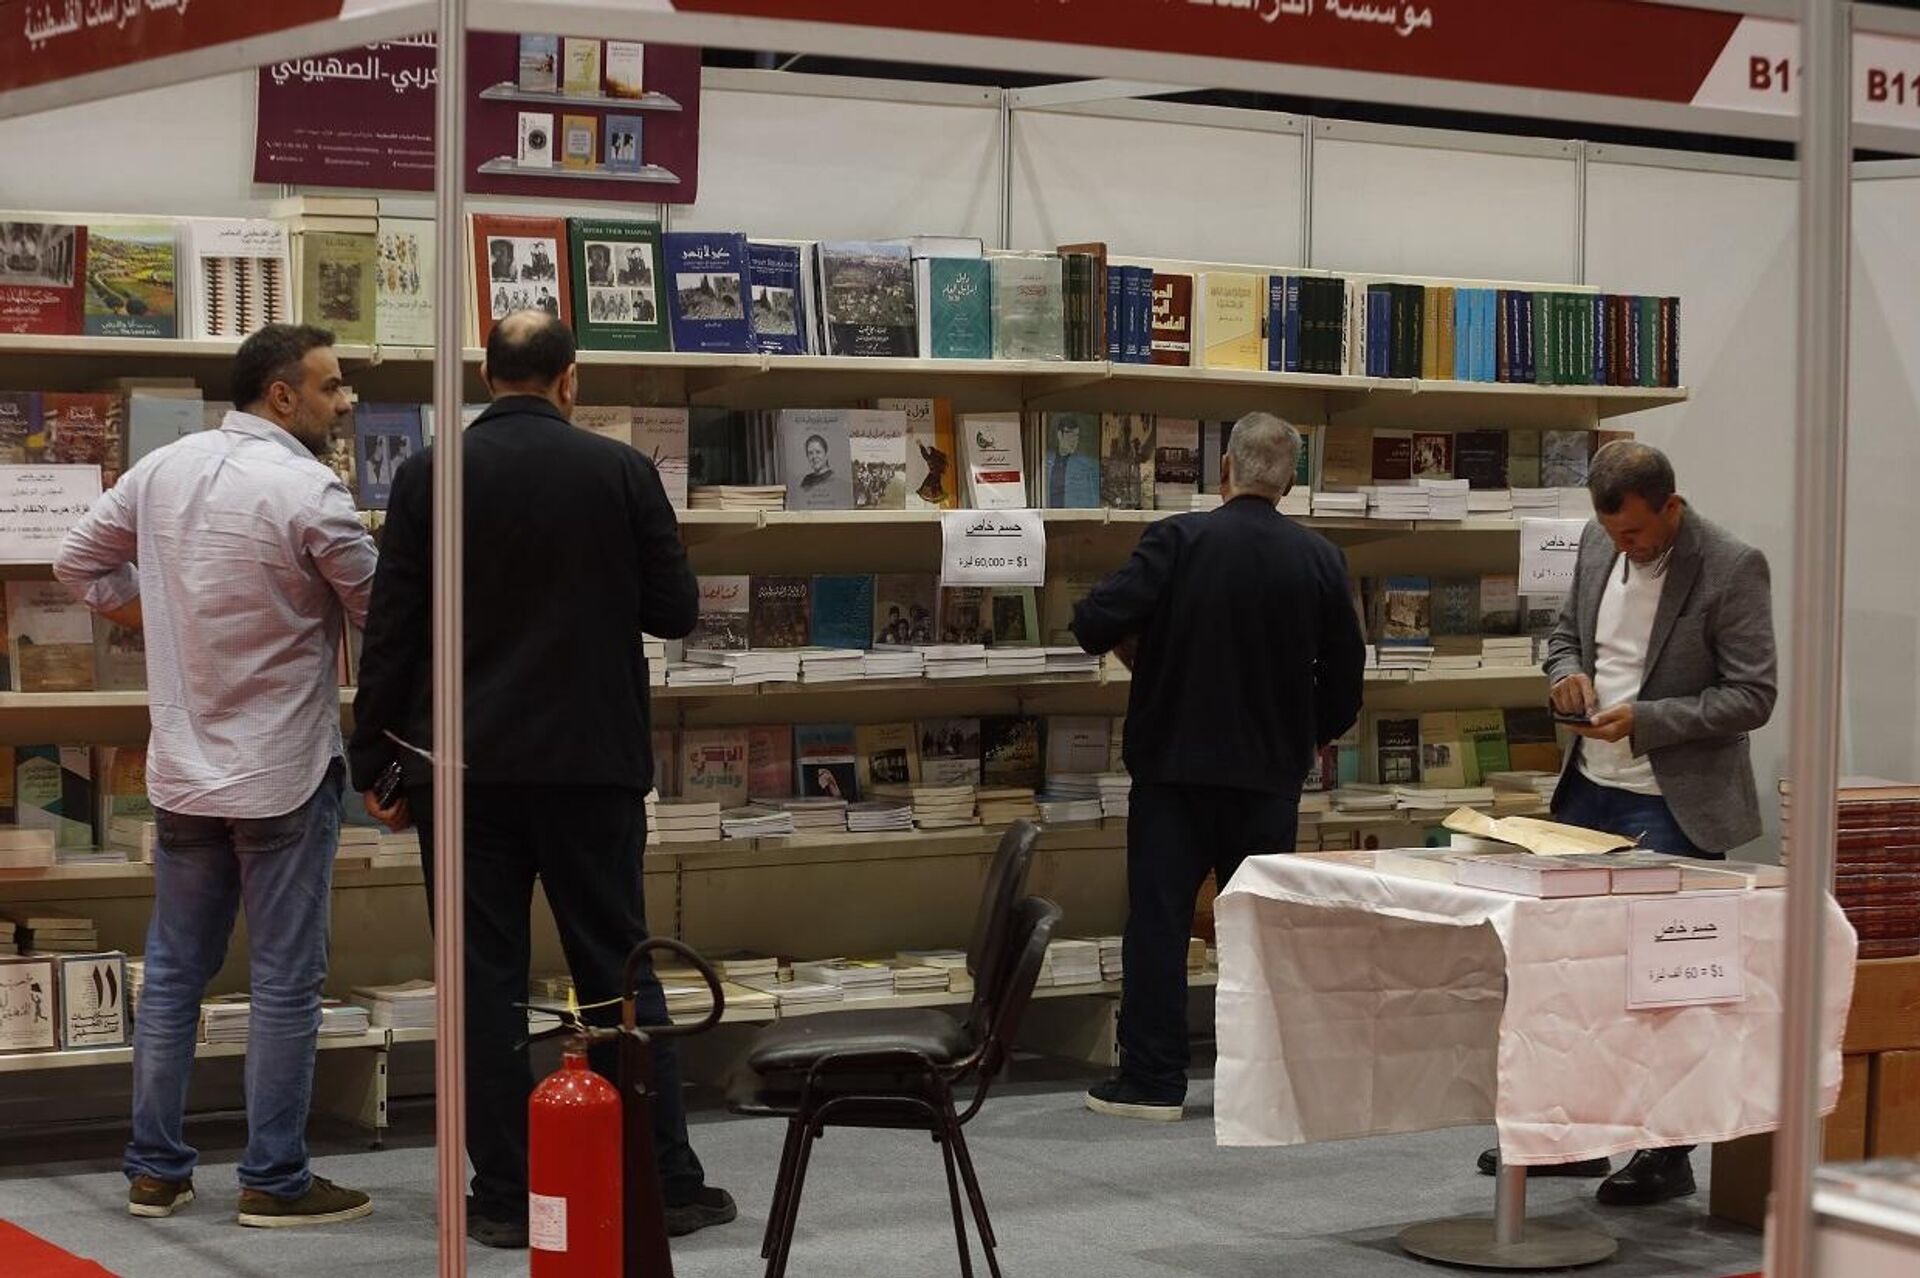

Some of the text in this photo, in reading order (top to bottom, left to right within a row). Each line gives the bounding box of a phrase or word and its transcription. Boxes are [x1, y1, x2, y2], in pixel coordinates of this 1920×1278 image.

[1749, 55, 1803, 93] B1
[965, 518, 1023, 536] حسم خاص
[974, 556, 1006, 569] 60,000
[1655, 919, 1718, 940] حسم خاص
[1684, 966, 1698, 979] 60
